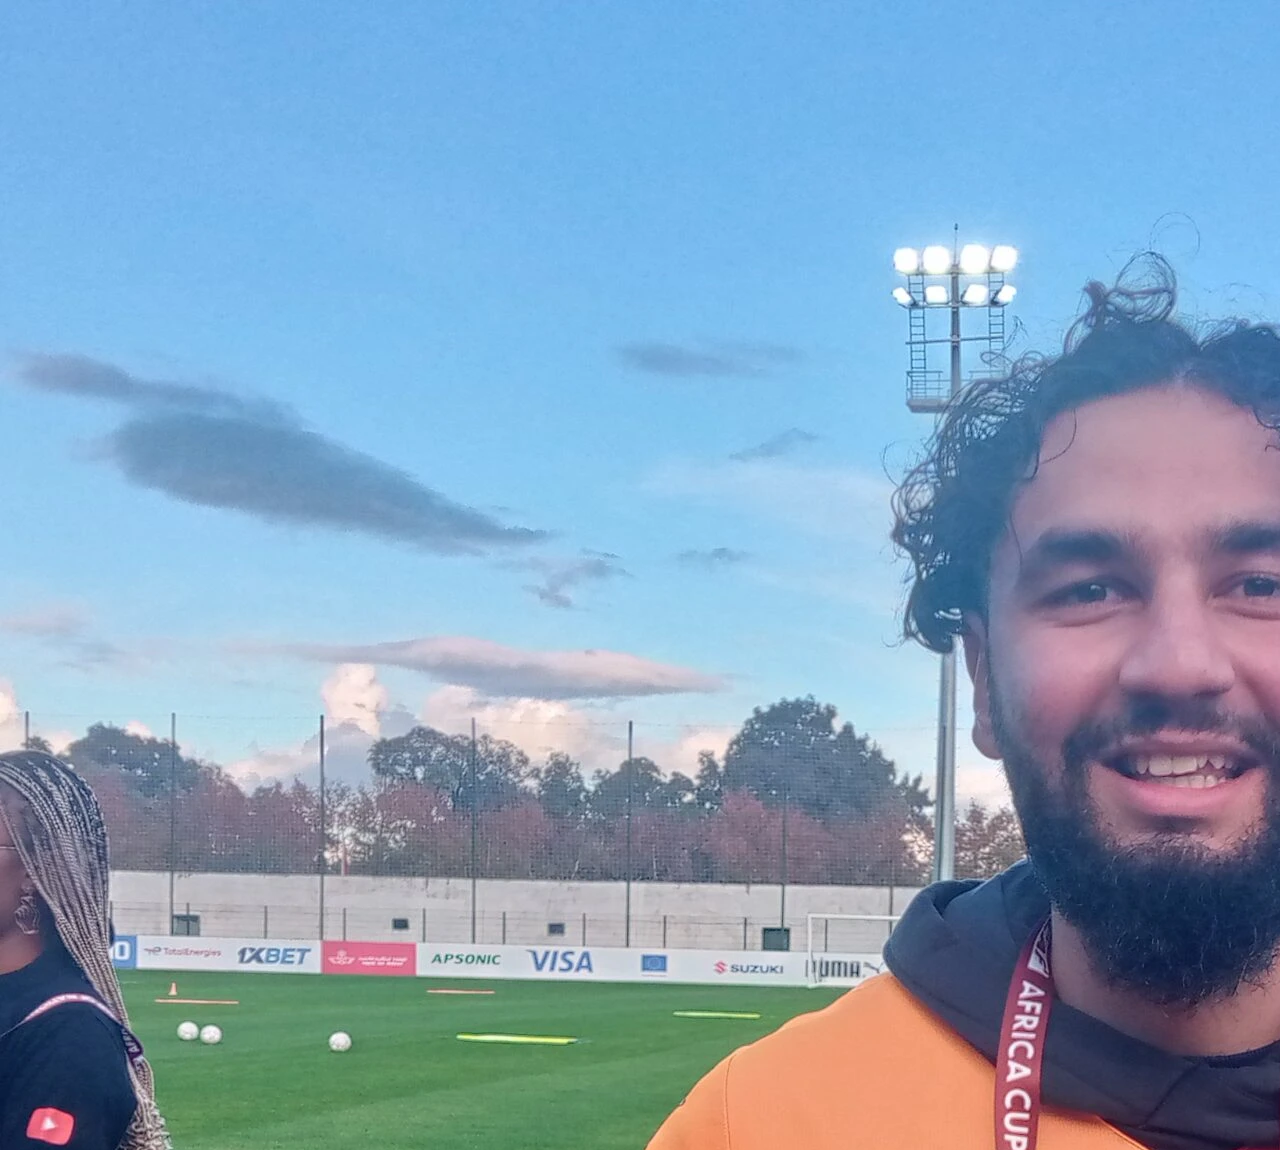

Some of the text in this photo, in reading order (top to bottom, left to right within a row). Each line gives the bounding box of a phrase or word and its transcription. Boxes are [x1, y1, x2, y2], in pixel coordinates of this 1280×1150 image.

[164, 947, 222, 957] TotalEnergies
[238, 946, 311, 964] 1XBET
[432, 953, 501, 965] APSONIC
[526, 949, 593, 973] VISA
[730, 964, 784, 974] SUZUKI
[1006, 979, 1046, 1083] AFRICA
